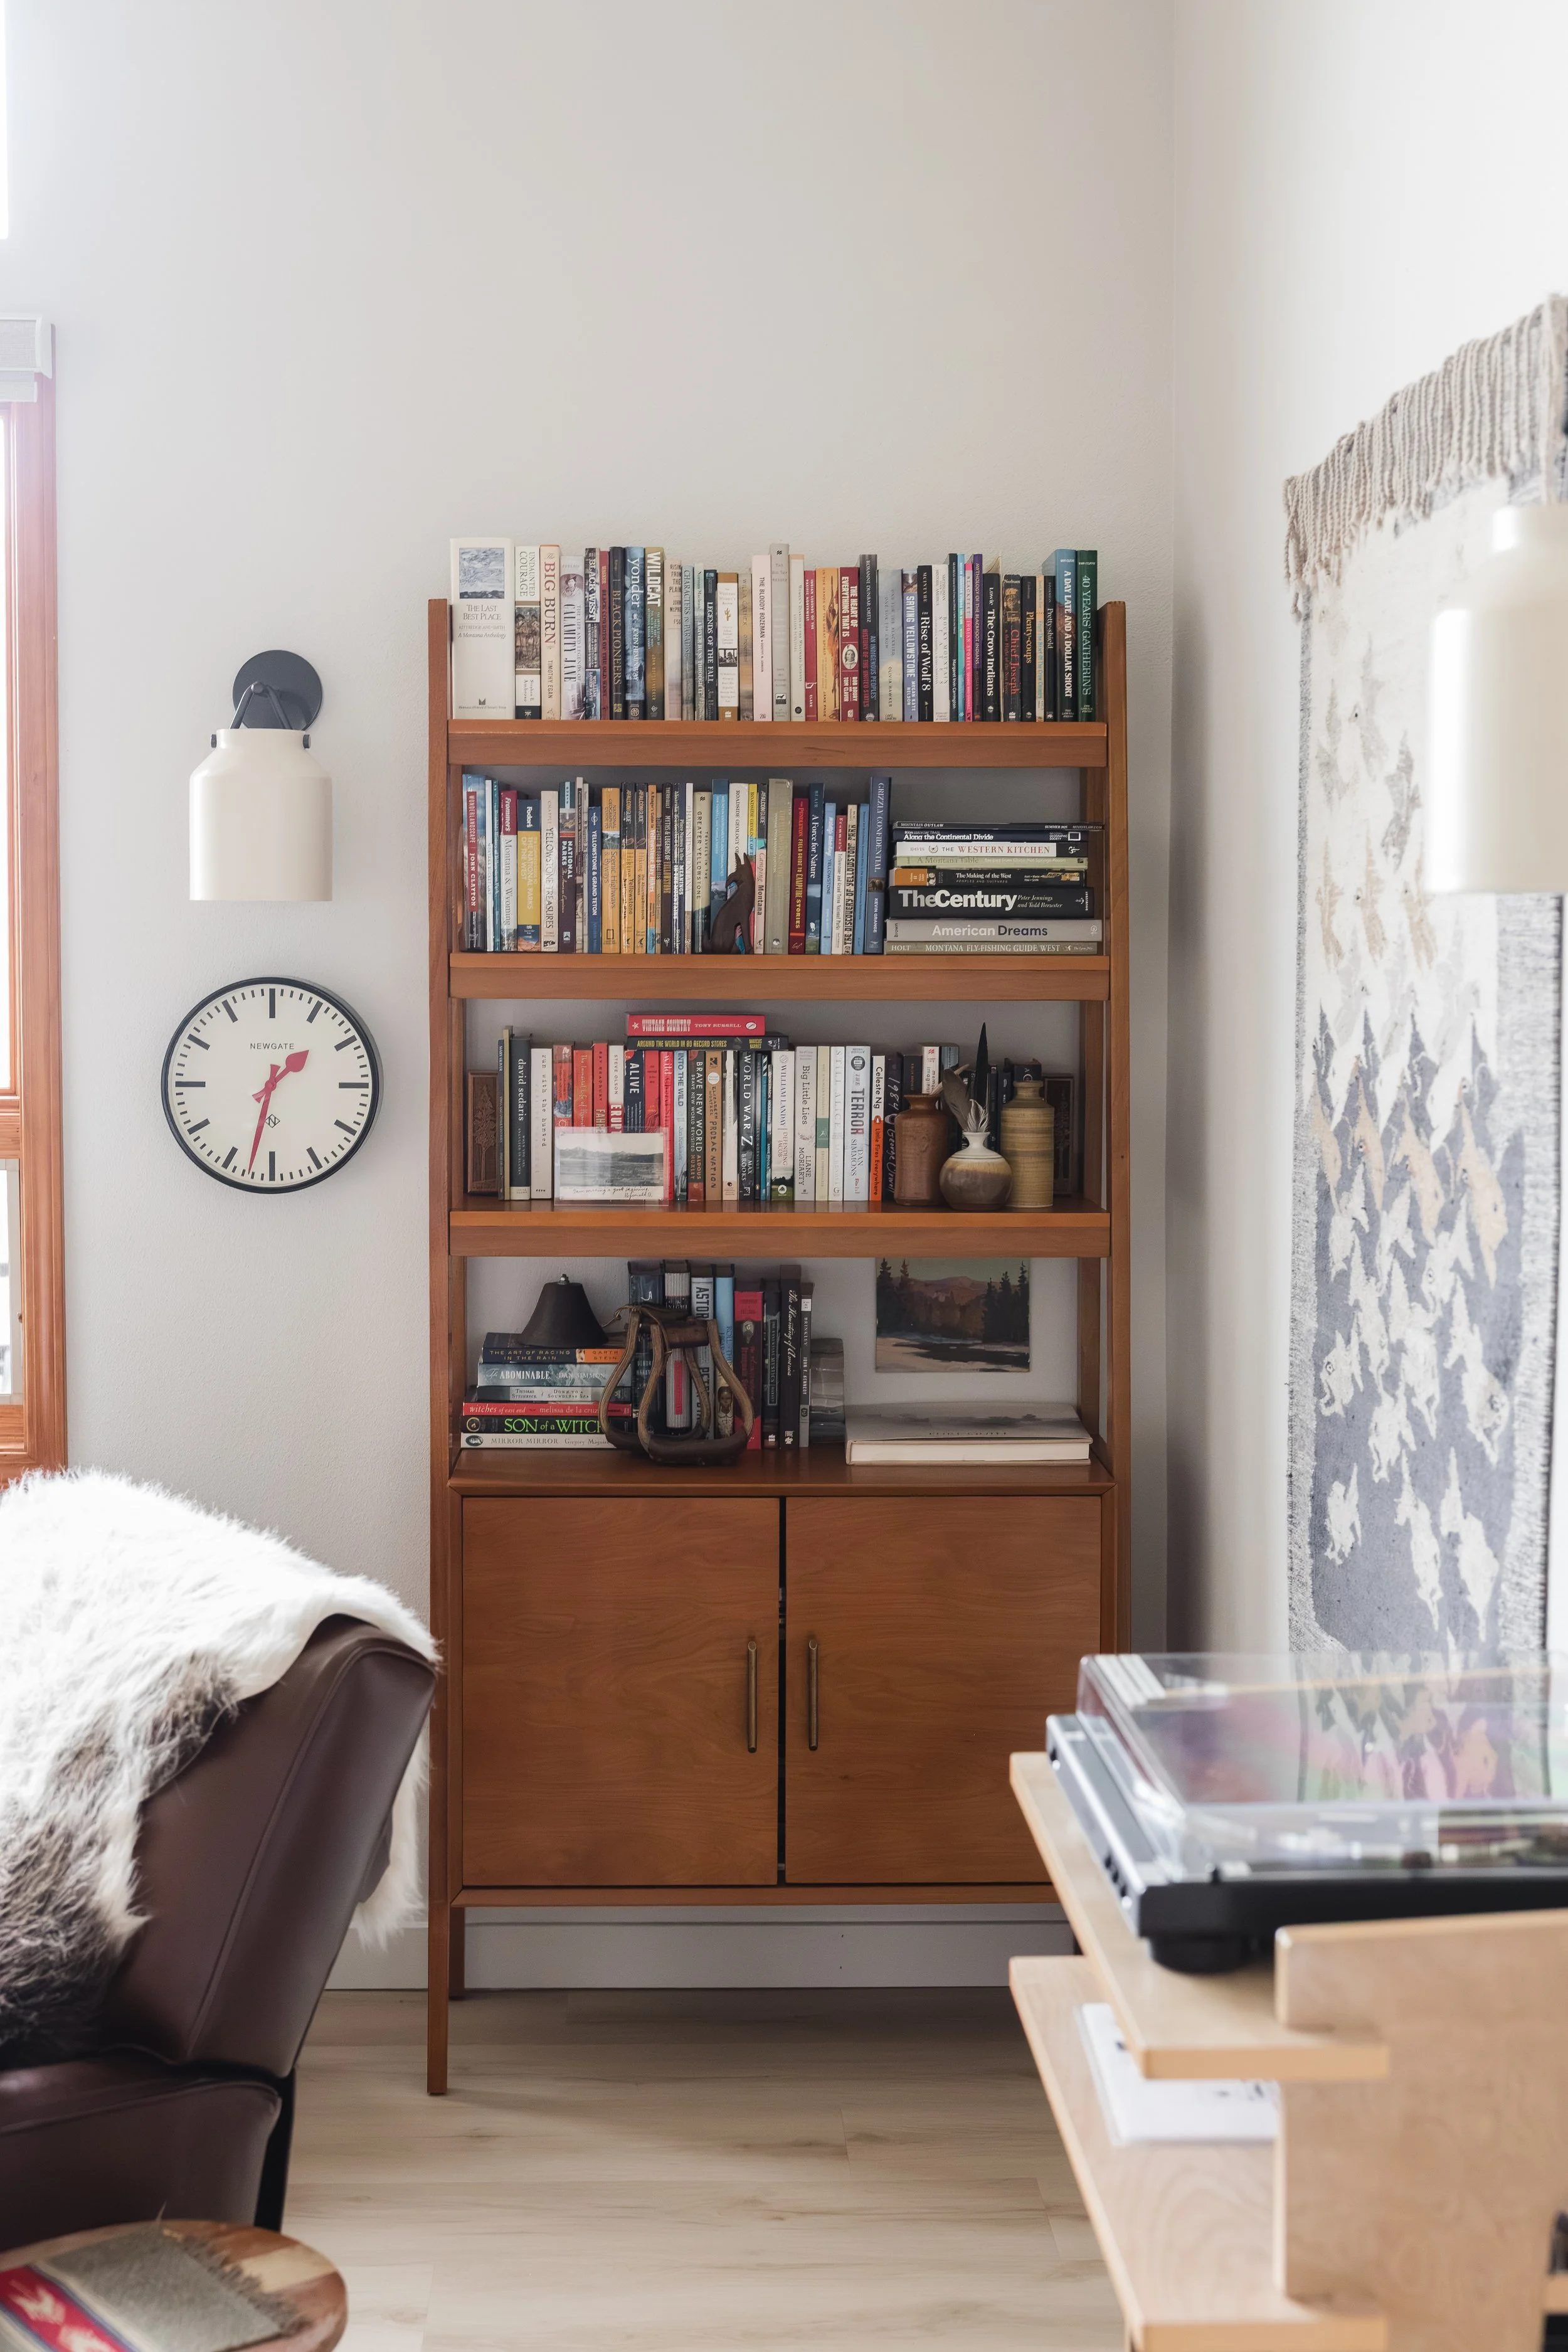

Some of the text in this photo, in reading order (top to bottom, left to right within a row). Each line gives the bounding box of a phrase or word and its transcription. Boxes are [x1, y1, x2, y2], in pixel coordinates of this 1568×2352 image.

[628, 558, 640, 607] yonder
[647, 552, 660, 607] WILDCAT
[1083, 576, 1090, 587] 40
[544, 562, 555, 644] BIG BURN
[987, 609, 995, 628] The
[1083, 591, 1091, 629] YEARS'
[563, 604, 576, 682] CALAMITY JANE
[613, 590, 622, 685] BLACK PIONEERS
[707, 636, 713, 645] OF
[906, 596, 915, 677] SAVING YELLOWSTONE
[921, 617, 930, 640] Rise
[1024, 612, 1034, 663] Plenty-coups
[921, 644, 930, 654] of
[921, 655, 931, 682] Wolf
[987, 659, 995, 696] Indians
[1010, 662, 1019, 695] Joseph
[874, 817, 883, 872] CONFIDENTIAL
[504, 888, 512, 925] Wyoming
[609, 876, 617, 908] Highways
[933, 925, 1048, 936] American Dreams
[642, 1019, 691, 1032] VINTAGE COUNTRY
[630, 1063, 639, 1093] ALIVE
[743, 1054, 751, 1099] WORLD
[874, 1097, 881, 1108] Ng
[887, 1078, 901, 1110] 1984
[850, 1088, 865, 1135] TERROR
[741, 1136, 753, 1146] Z
[784, 1290, 798, 1377] The Haunting of America
[500, 1370, 550, 1379] ABOMINABLE
[504, 1419, 538, 1433] SON
[540, 1421, 548, 1431] of
